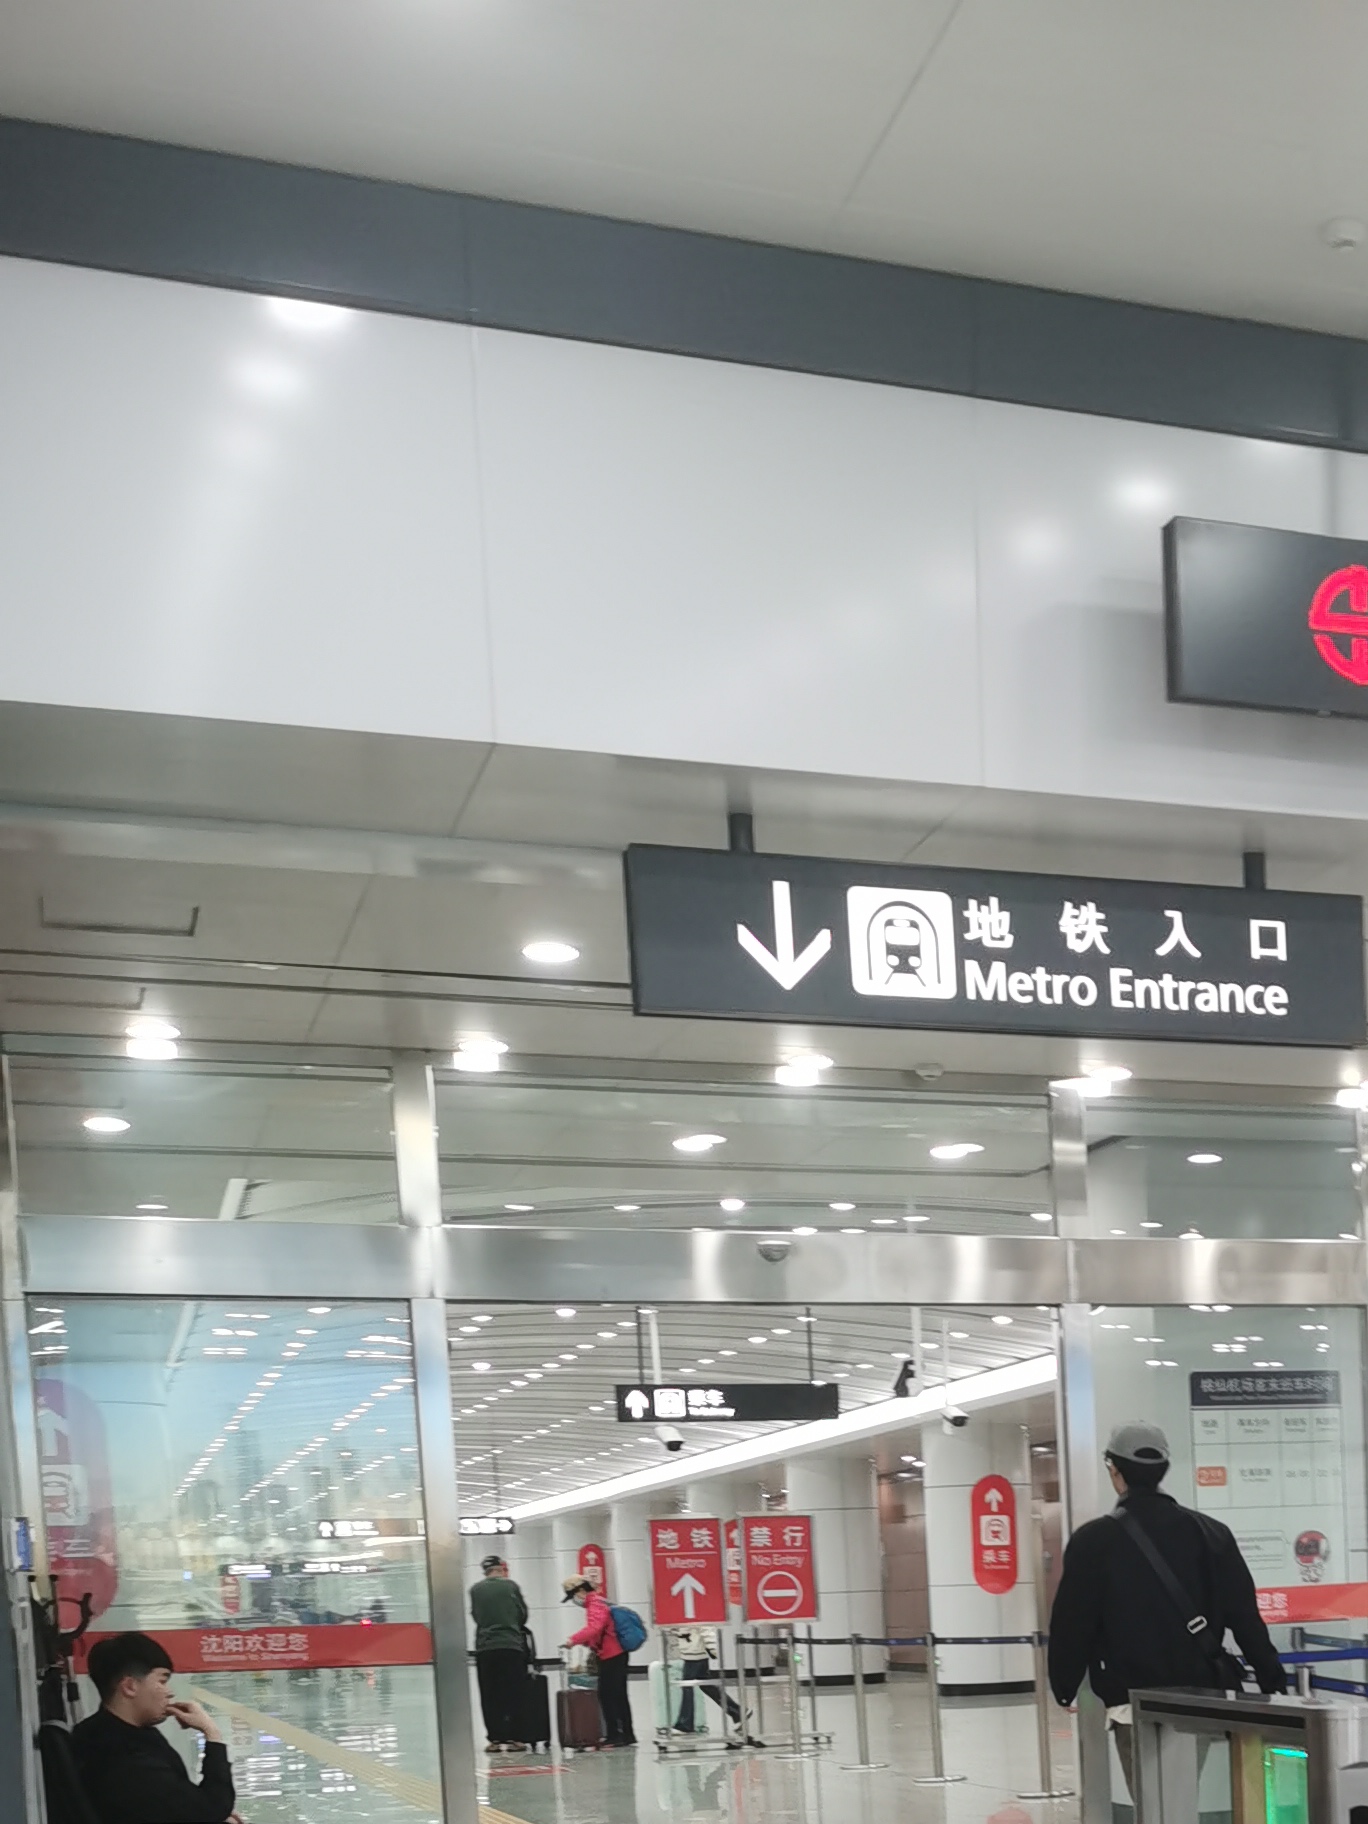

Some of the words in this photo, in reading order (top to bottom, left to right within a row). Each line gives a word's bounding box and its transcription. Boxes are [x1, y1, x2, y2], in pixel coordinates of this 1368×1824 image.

[963, 896, 1289, 962] 地铁入口
[964, 959, 1098, 1008] Metro
[1110, 967, 1289, 1016] Entrance
[656, 1527, 714, 1549] 地铁
[750, 1526, 805, 1547] 禁行
[666, 1556, 707, 1569] Metro
[751, 1554, 771, 1566] No
[773, 1553, 805, 1568] Entry
[200, 1633, 310, 1653] 沈阳欢迎您
